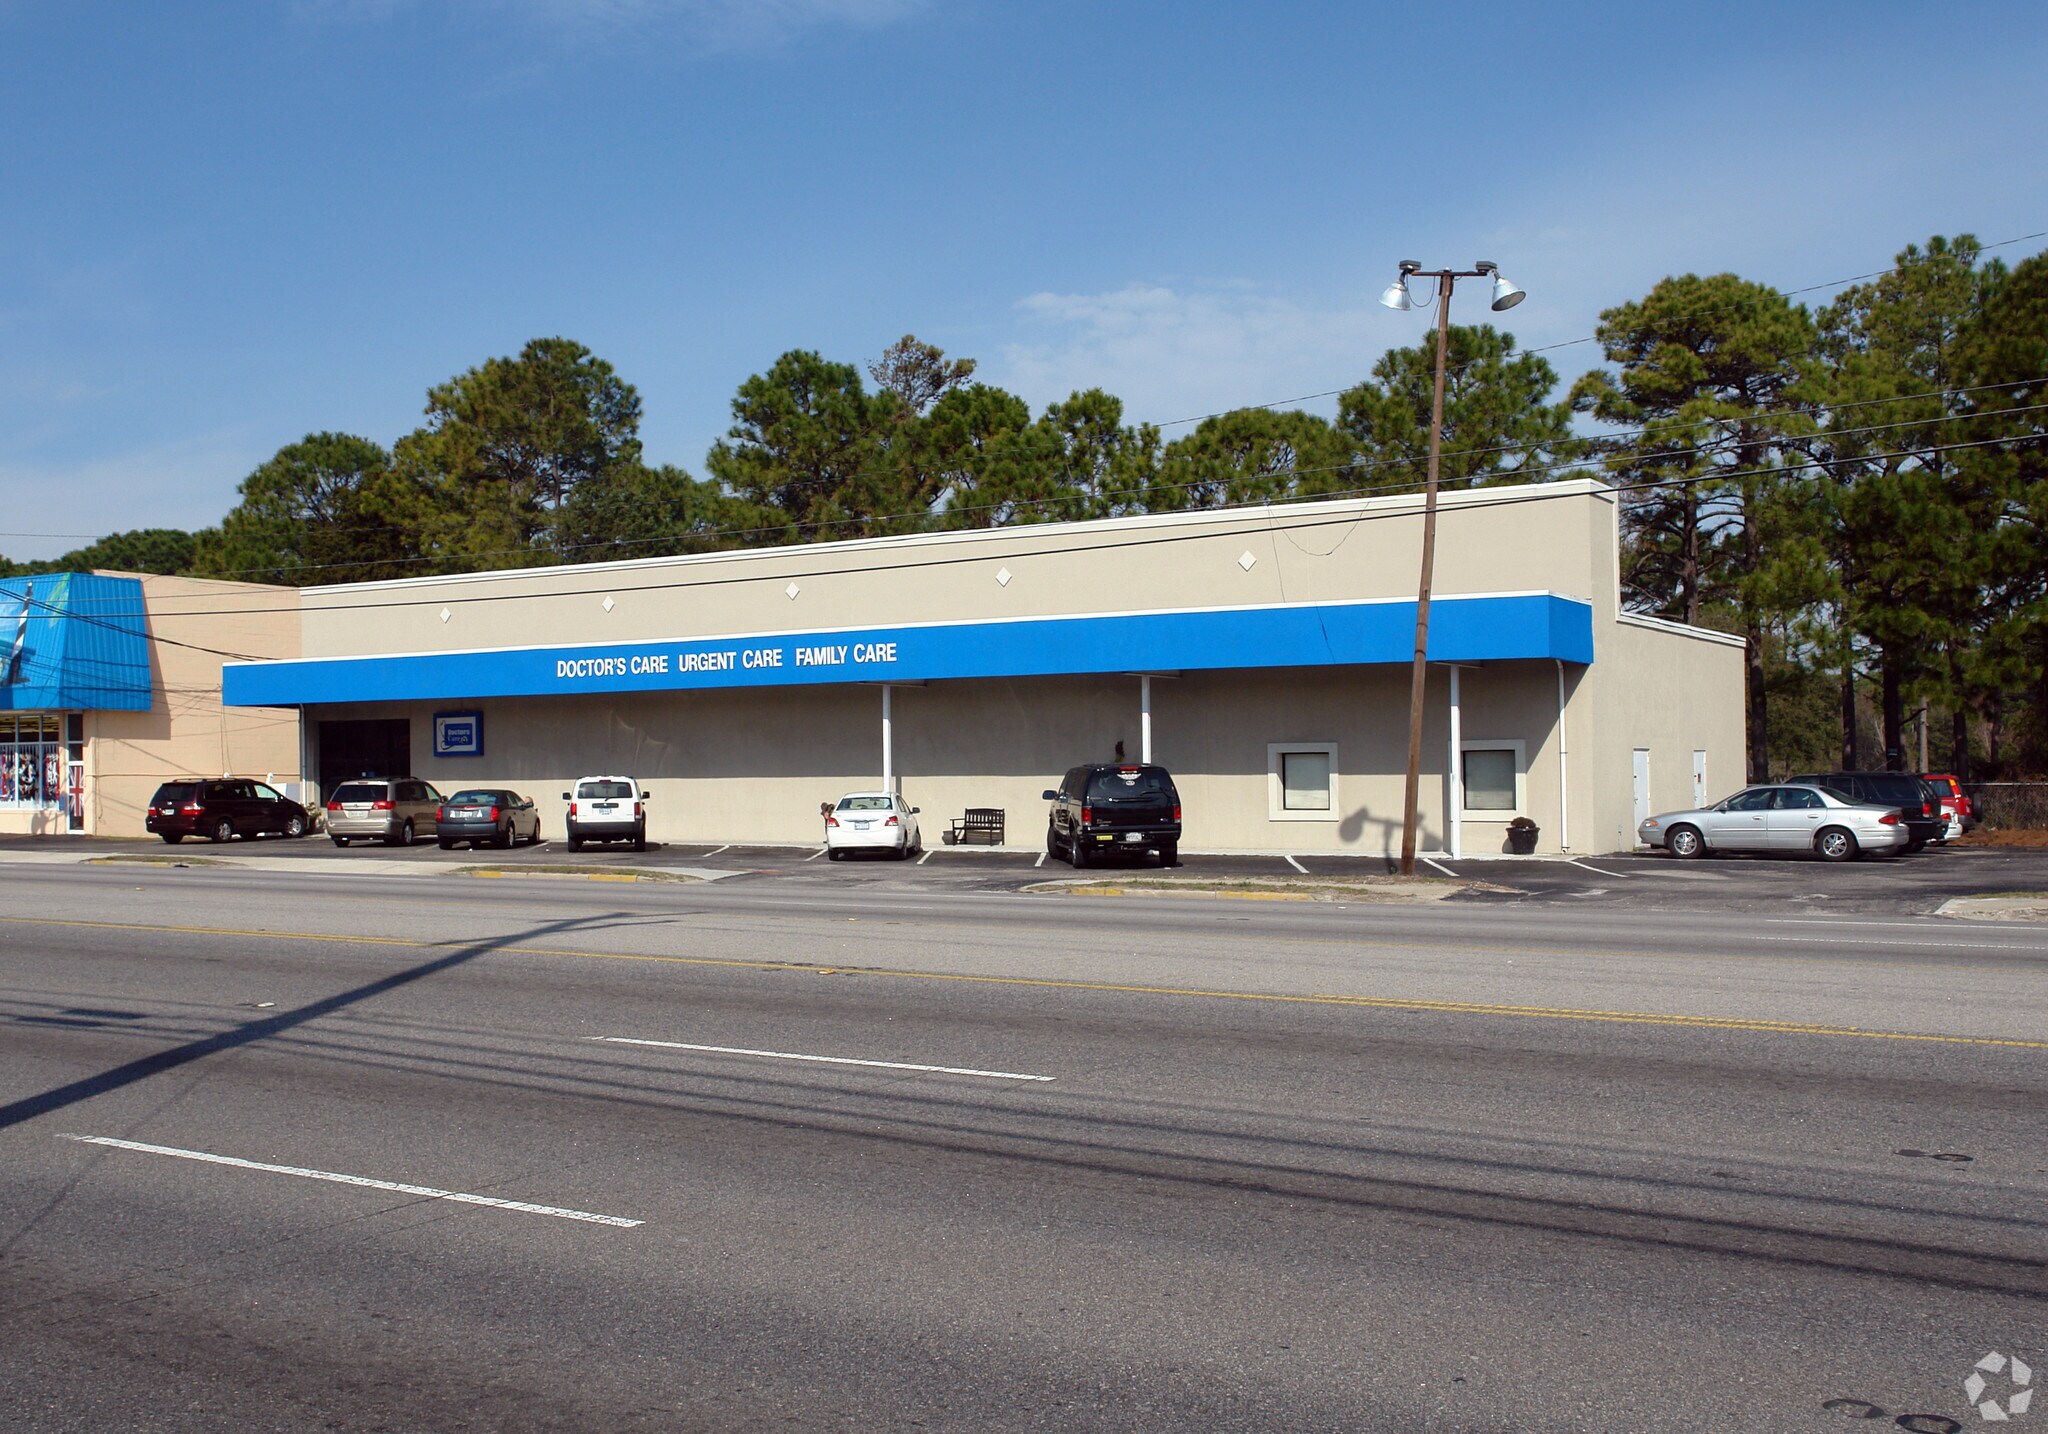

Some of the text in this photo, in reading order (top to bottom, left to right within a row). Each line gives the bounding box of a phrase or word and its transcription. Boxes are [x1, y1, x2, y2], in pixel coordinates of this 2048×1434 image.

[557, 643, 898, 678] DOCTOR'S CARE URGENT CARE FAMILY CARE
